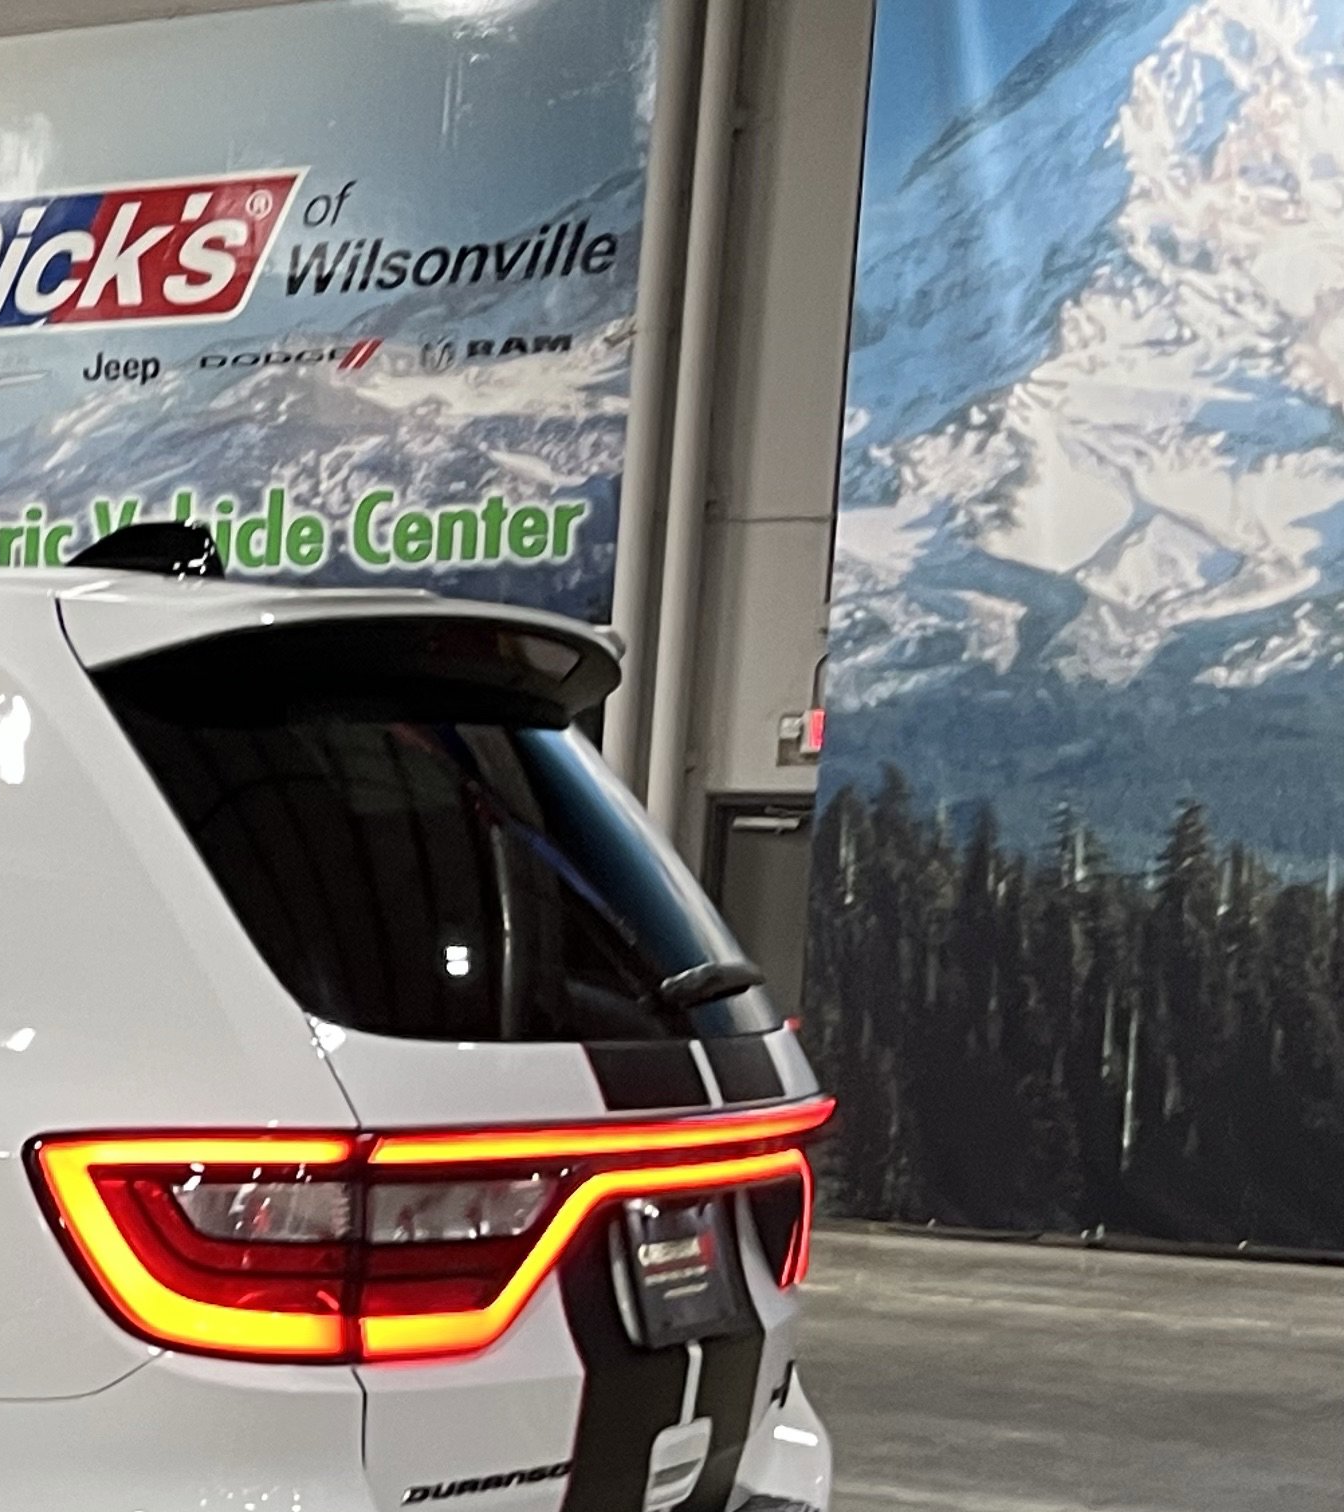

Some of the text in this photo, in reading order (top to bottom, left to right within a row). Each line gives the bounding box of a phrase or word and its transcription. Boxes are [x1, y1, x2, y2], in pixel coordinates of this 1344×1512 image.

[302, 180, 358, 227] of
[286, 215, 619, 296] Wilsonville
[82, 351, 160, 385] Jeep
[466, 334, 573, 359] RAM
[93, 487, 325, 569] Vicle
[353, 489, 586, 565] Center
